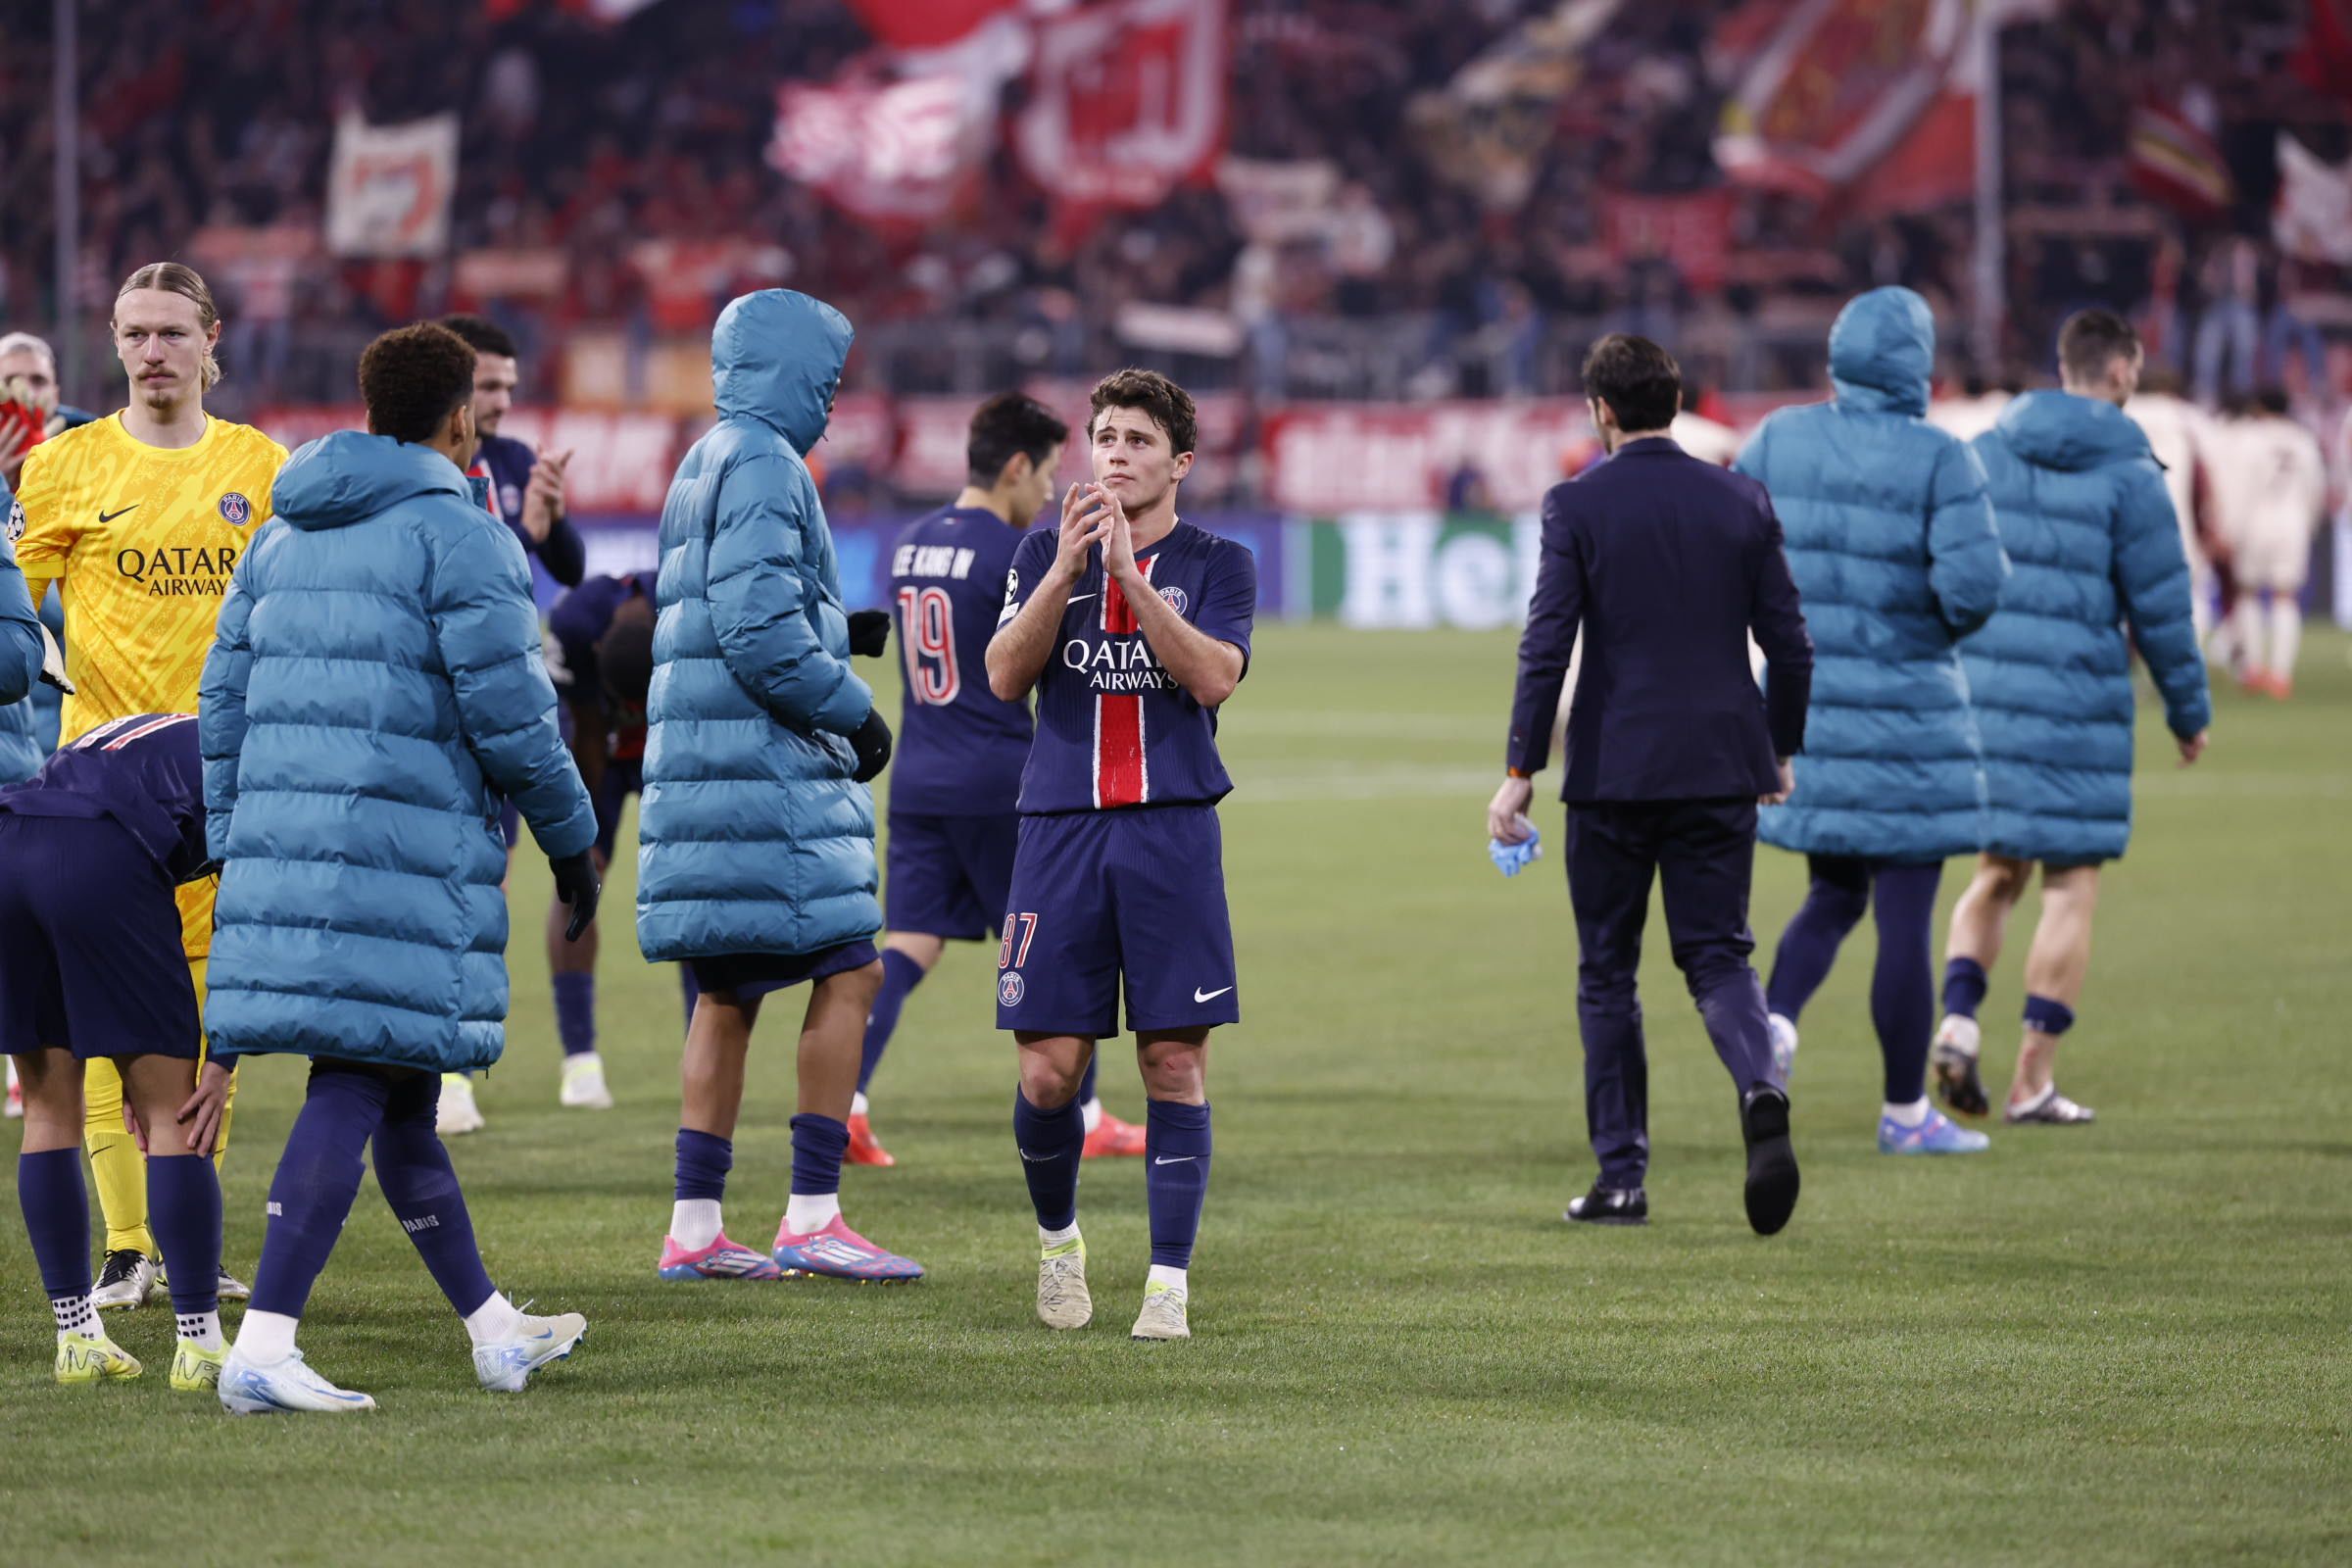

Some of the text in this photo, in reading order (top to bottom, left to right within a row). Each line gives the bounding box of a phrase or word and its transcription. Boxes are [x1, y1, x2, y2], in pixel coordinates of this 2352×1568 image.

[222, 495, 244, 505] PARIS
[117, 548, 236, 583] QATAR
[148, 578, 228, 596] AIRWAY
[1159, 588, 1182, 597] PARIS
[897, 586, 960, 706] 19
[1063, 639, 1162, 674] QATA
[1089, 670, 1179, 690] AIRWAYS
[999, 912, 1038, 969] 87
[267, 1201, 282, 1216] RIS
[402, 1214, 439, 1233] PARIS
